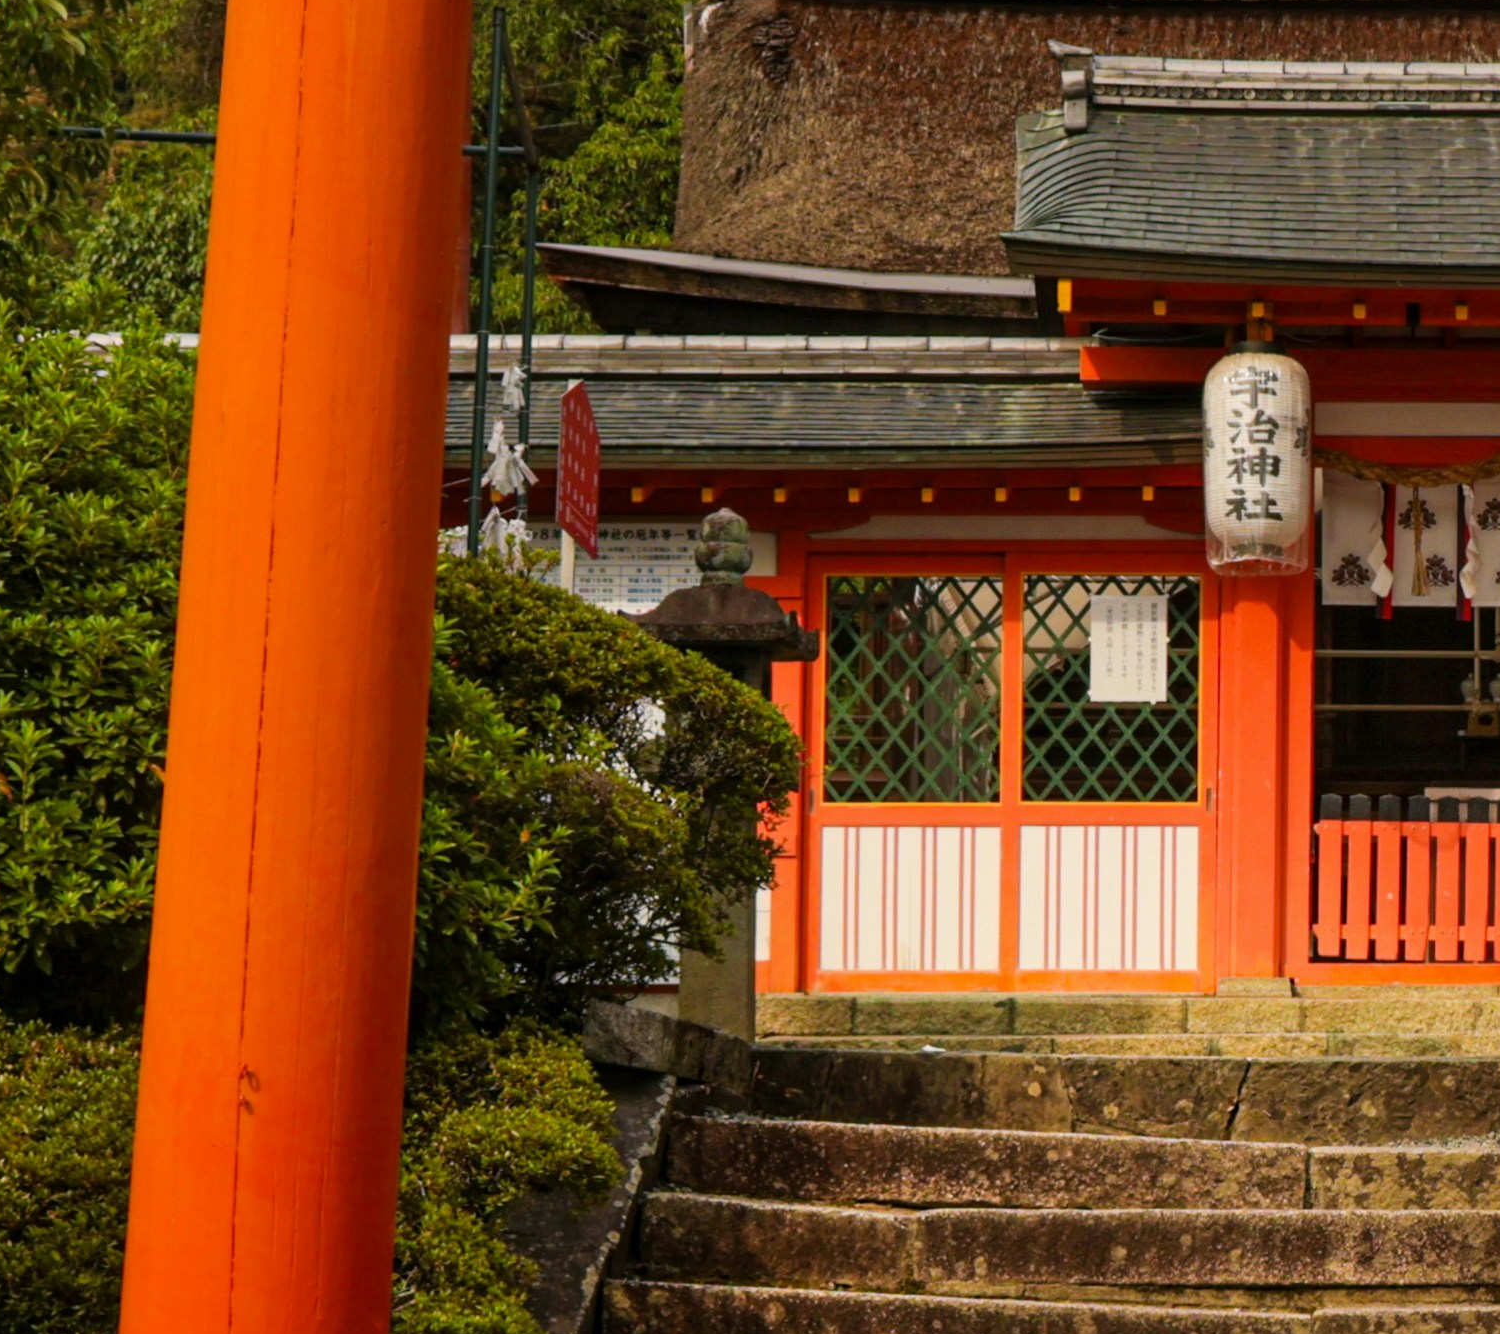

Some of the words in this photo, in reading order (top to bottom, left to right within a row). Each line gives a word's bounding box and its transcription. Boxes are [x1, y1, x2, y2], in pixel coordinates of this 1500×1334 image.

[1224, 367, 1284, 522] 宇治神社
[598, 529, 702, 540] 神社の厄年等一覧
